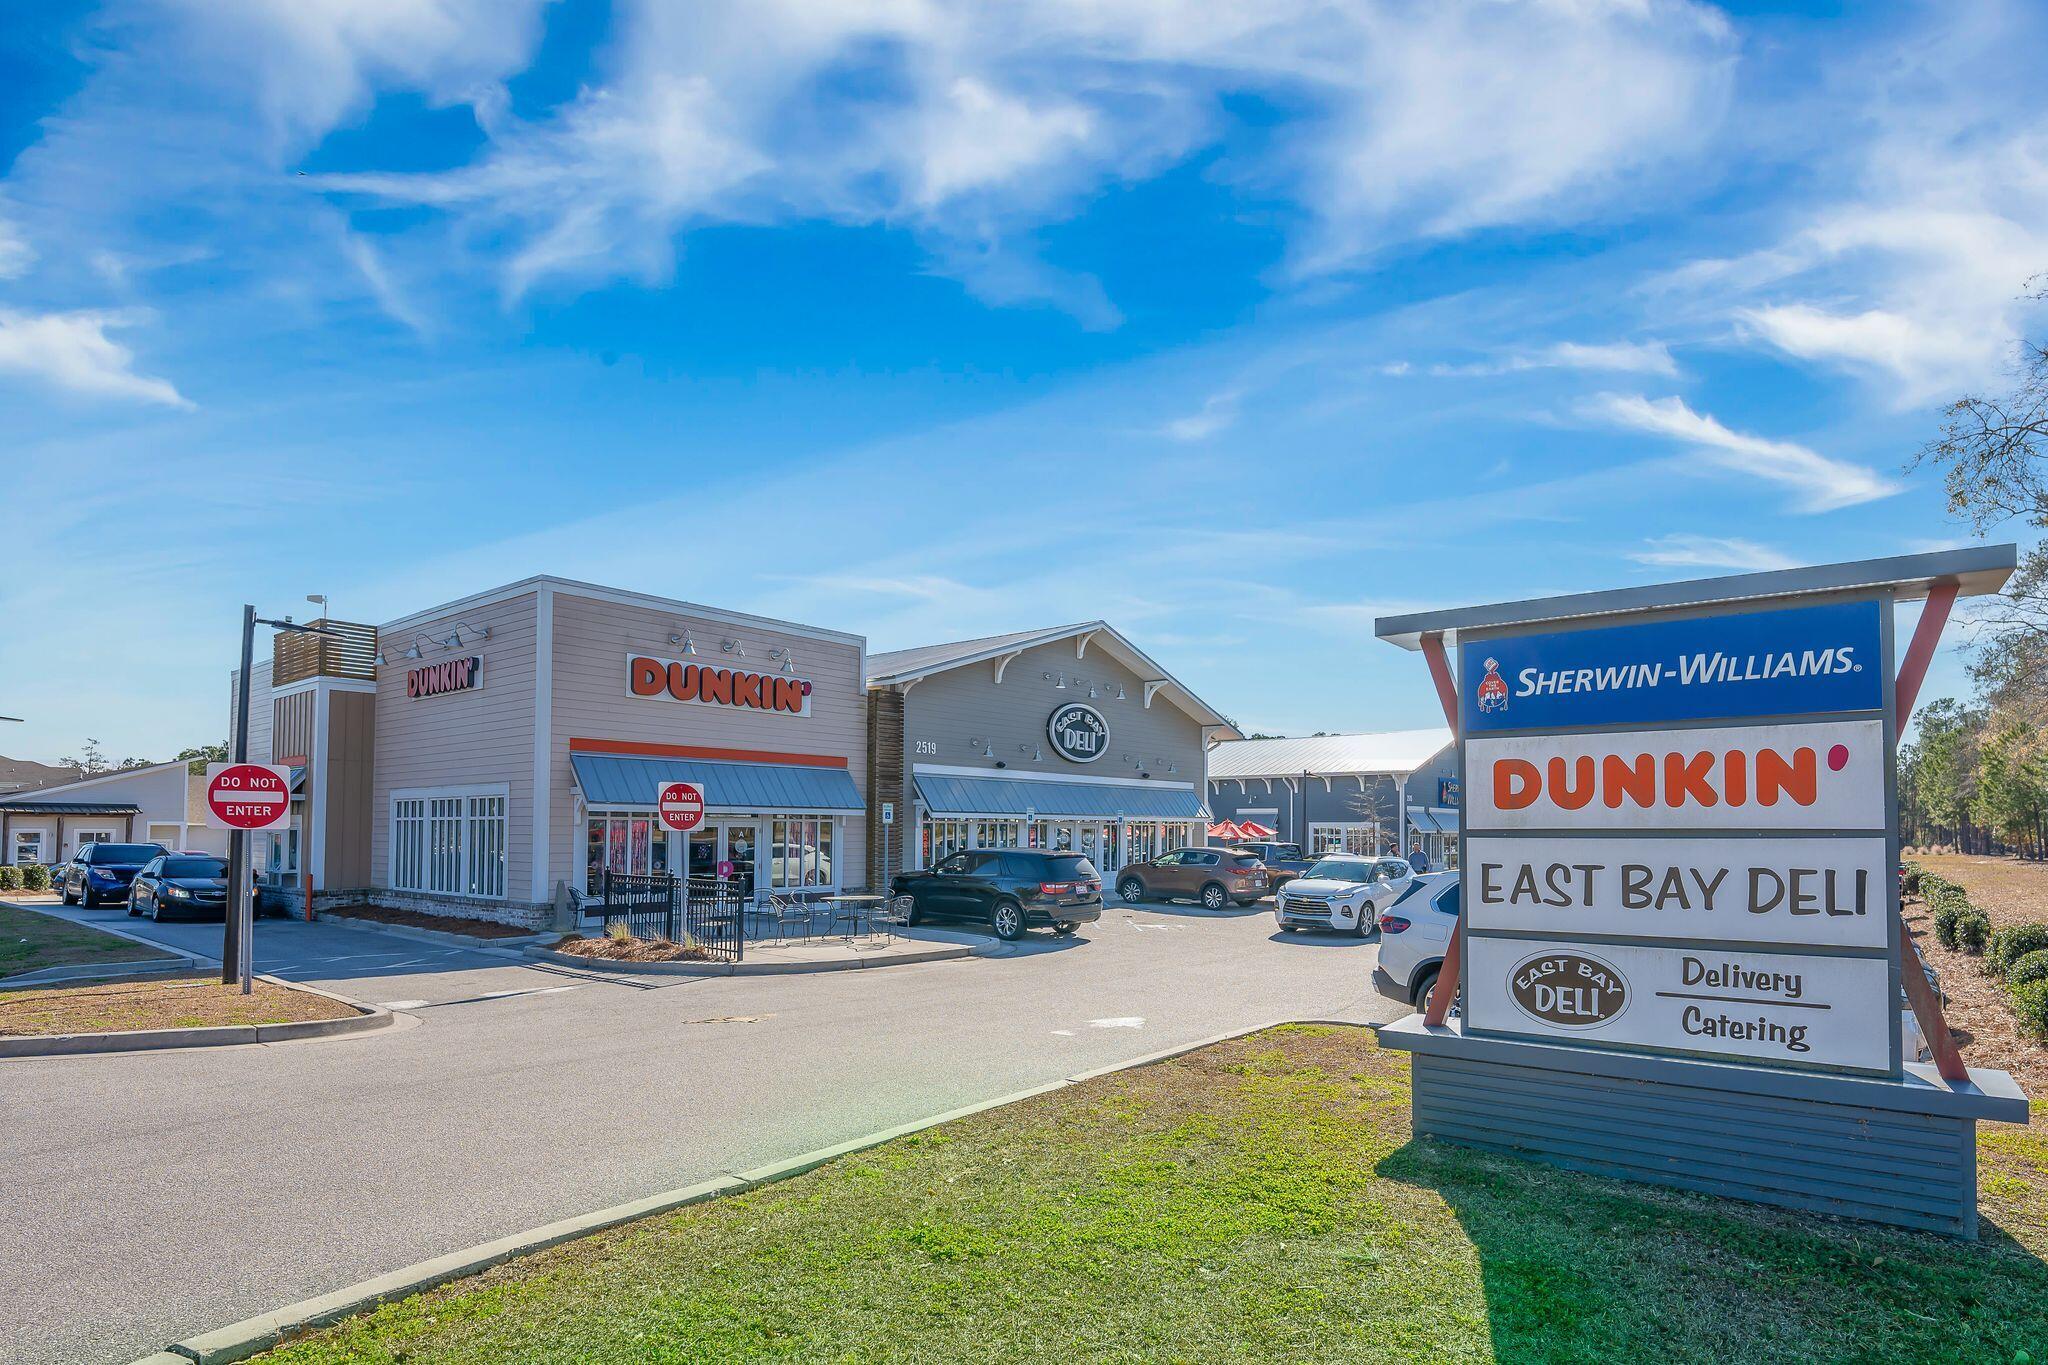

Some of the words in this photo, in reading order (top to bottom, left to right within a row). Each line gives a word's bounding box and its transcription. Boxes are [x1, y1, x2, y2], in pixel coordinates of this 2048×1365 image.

[407, 655, 474, 698] DUNKIN'
[631, 656, 812, 713] DUNKIN'
[1056, 711, 1082, 732] EAST
[1084, 713, 1106, 737] BAY
[915, 740, 936, 755] 2519
[1063, 728, 1096, 753] DELI
[221, 777, 240, 787] DO
[250, 778, 277, 788] NOT
[1492, 743, 1850, 811] DUNKIN'
[226, 805, 272, 816] ENTER
[666, 792, 677, 800] DO
[681, 793, 697, 801] NOT
[669, 813, 695, 821] ENTER
[1481, 862, 1604, 908] EAST
[1621, 864, 1729, 911] BAY
[1747, 867, 1867, 917] DELI
[1516, 959, 1568, 990] EAST
[1578, 962, 1622, 994] BAY
[1682, 956, 1802, 998] Delivery
[1682, 1005, 1811, 1052] Catering
